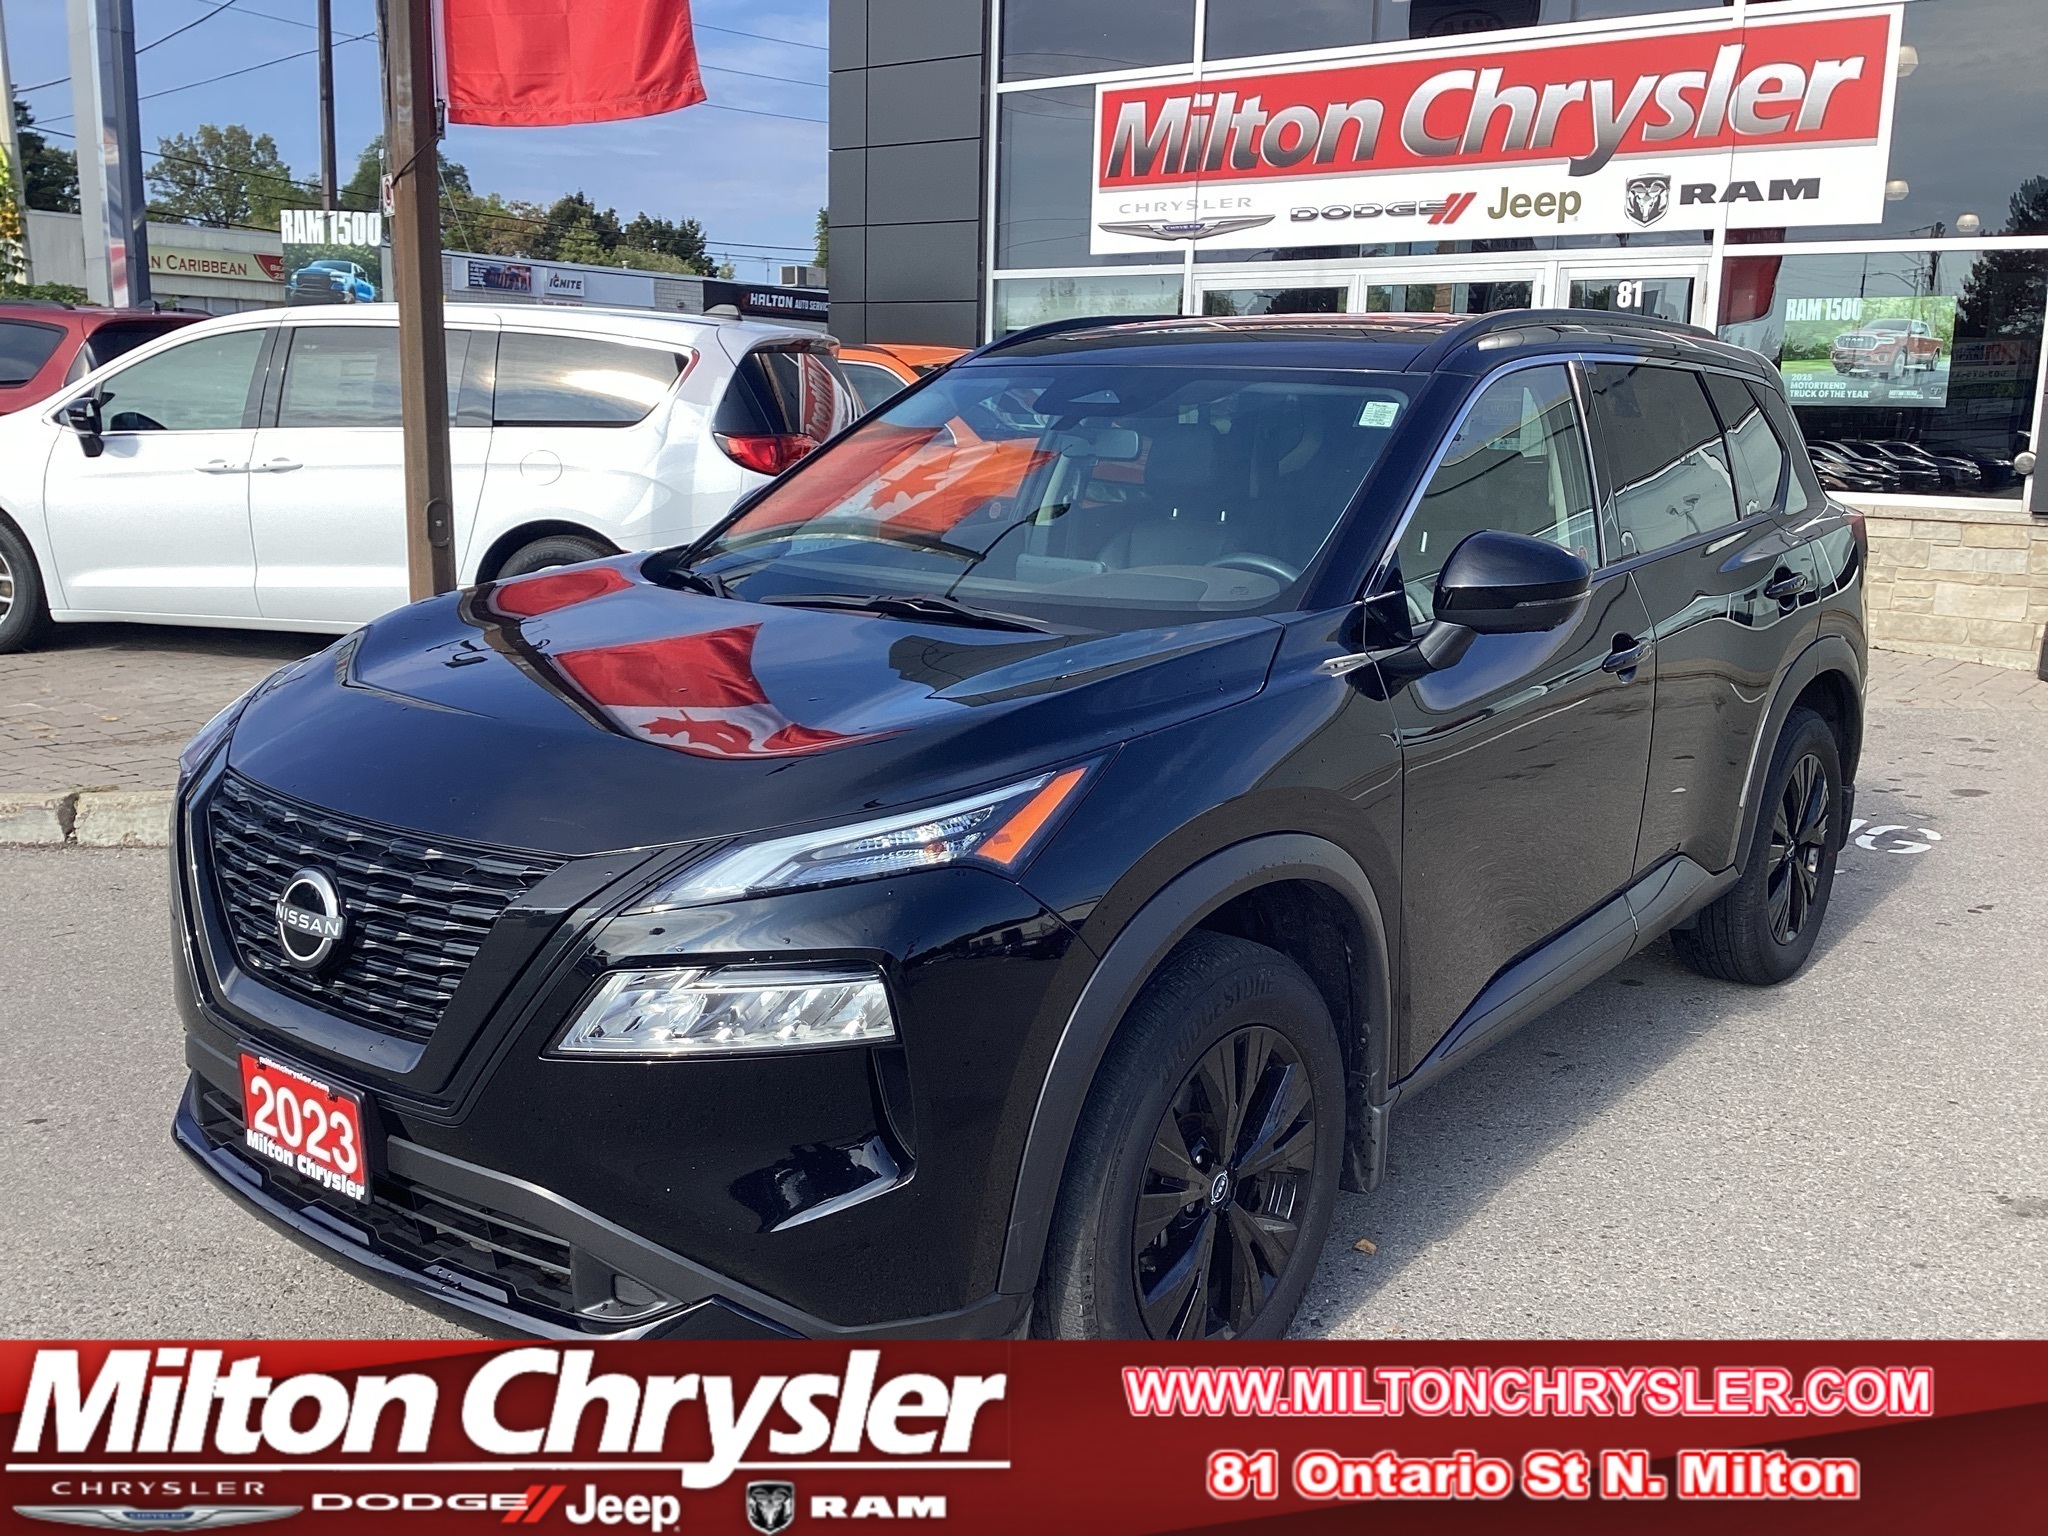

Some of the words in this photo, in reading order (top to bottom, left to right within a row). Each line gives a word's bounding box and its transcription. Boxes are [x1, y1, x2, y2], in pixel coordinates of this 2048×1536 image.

[1105, 91, 1385, 179] Milton
[1400, 42, 1865, 177] Chrysler
[1679, 177, 1821, 205] RAM
[1118, 197, 1252, 214] CHRYSLER
[1290, 200, 1447, 222] DODGE
[1487, 187, 1582, 223] Jeep
[280, 210, 325, 244] RAM
[327, 212, 382, 247] 1500
[166, 254, 248, 277] CARIBBEAN
[549, 276, 583, 291] IGNITE
[1616, 281, 1643, 308] 81
[749, 292, 793, 309] HALTON
[794, 300, 808, 310] AUTO
[1785, 298, 1822, 322] RAM
[1824, 297, 1862, 321] 1500
[1790, 382, 1847, 390] MOTORTREND
[1791, 373, 1813, 382] 2025
[1790, 390, 1819, 398] TRUCK
[1819, 390, 1829, 398] OF
[1847, 391, 1869, 399] YEAR
[275, 902, 340, 937] NISSAN
[258, 1056, 330, 1093] miltonchrysler.com
[251, 1075, 358, 1174] 2023
[246, 1128, 294, 1168] Milton
[296, 1153, 365, 1201] Chrysler
